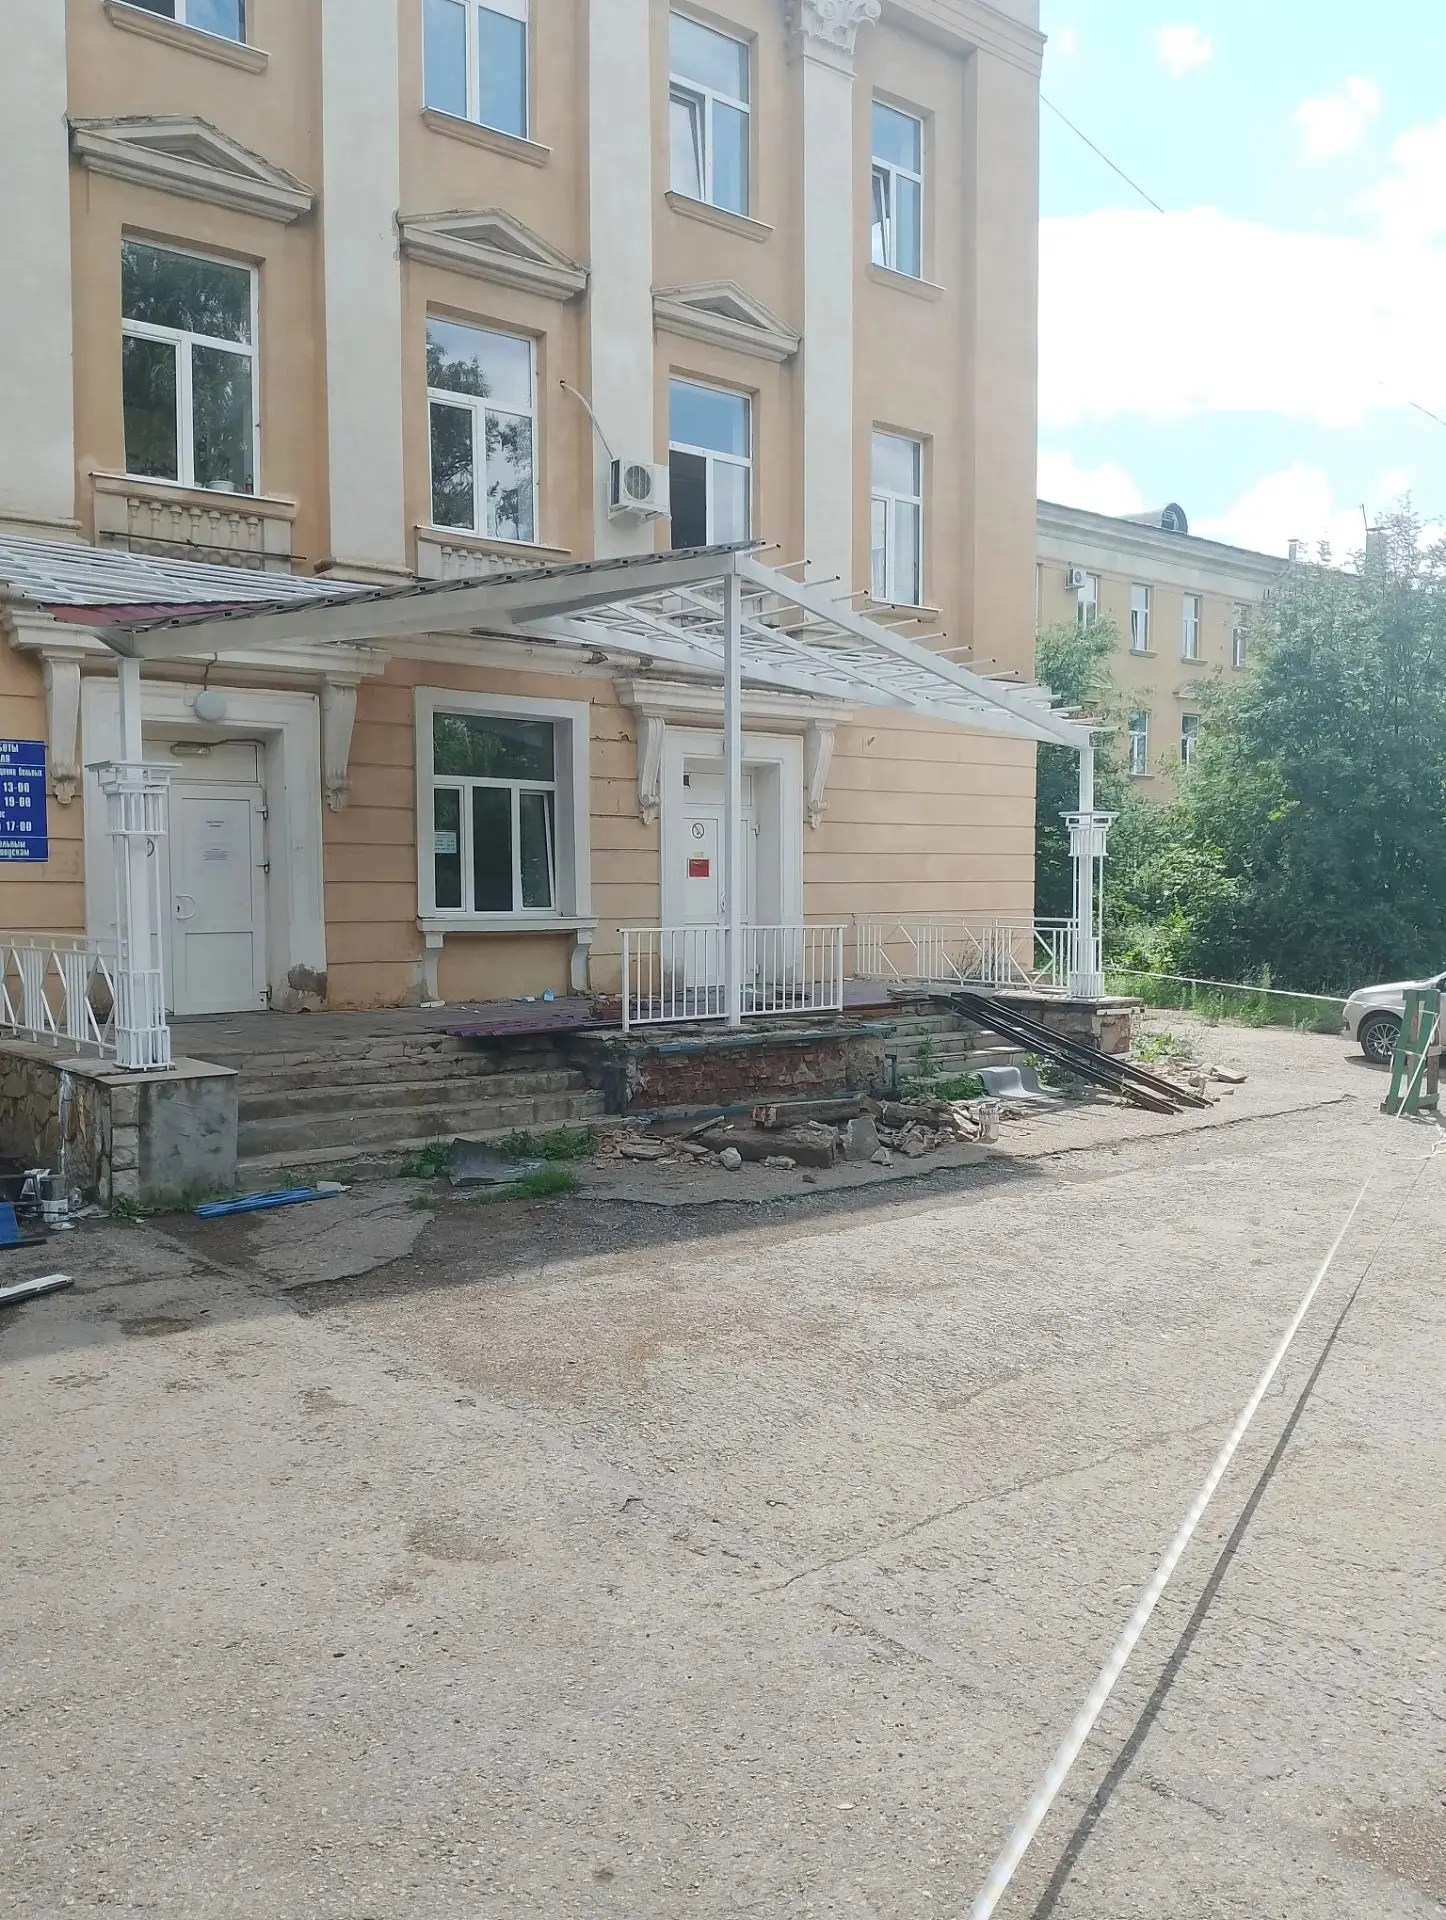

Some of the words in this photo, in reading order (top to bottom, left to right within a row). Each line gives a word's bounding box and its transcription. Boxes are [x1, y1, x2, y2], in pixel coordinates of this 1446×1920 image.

[3, 781, 30, 793] 13-00
[4, 796, 31, 808] 19-00
[6, 820, 32, 832] 17-00
